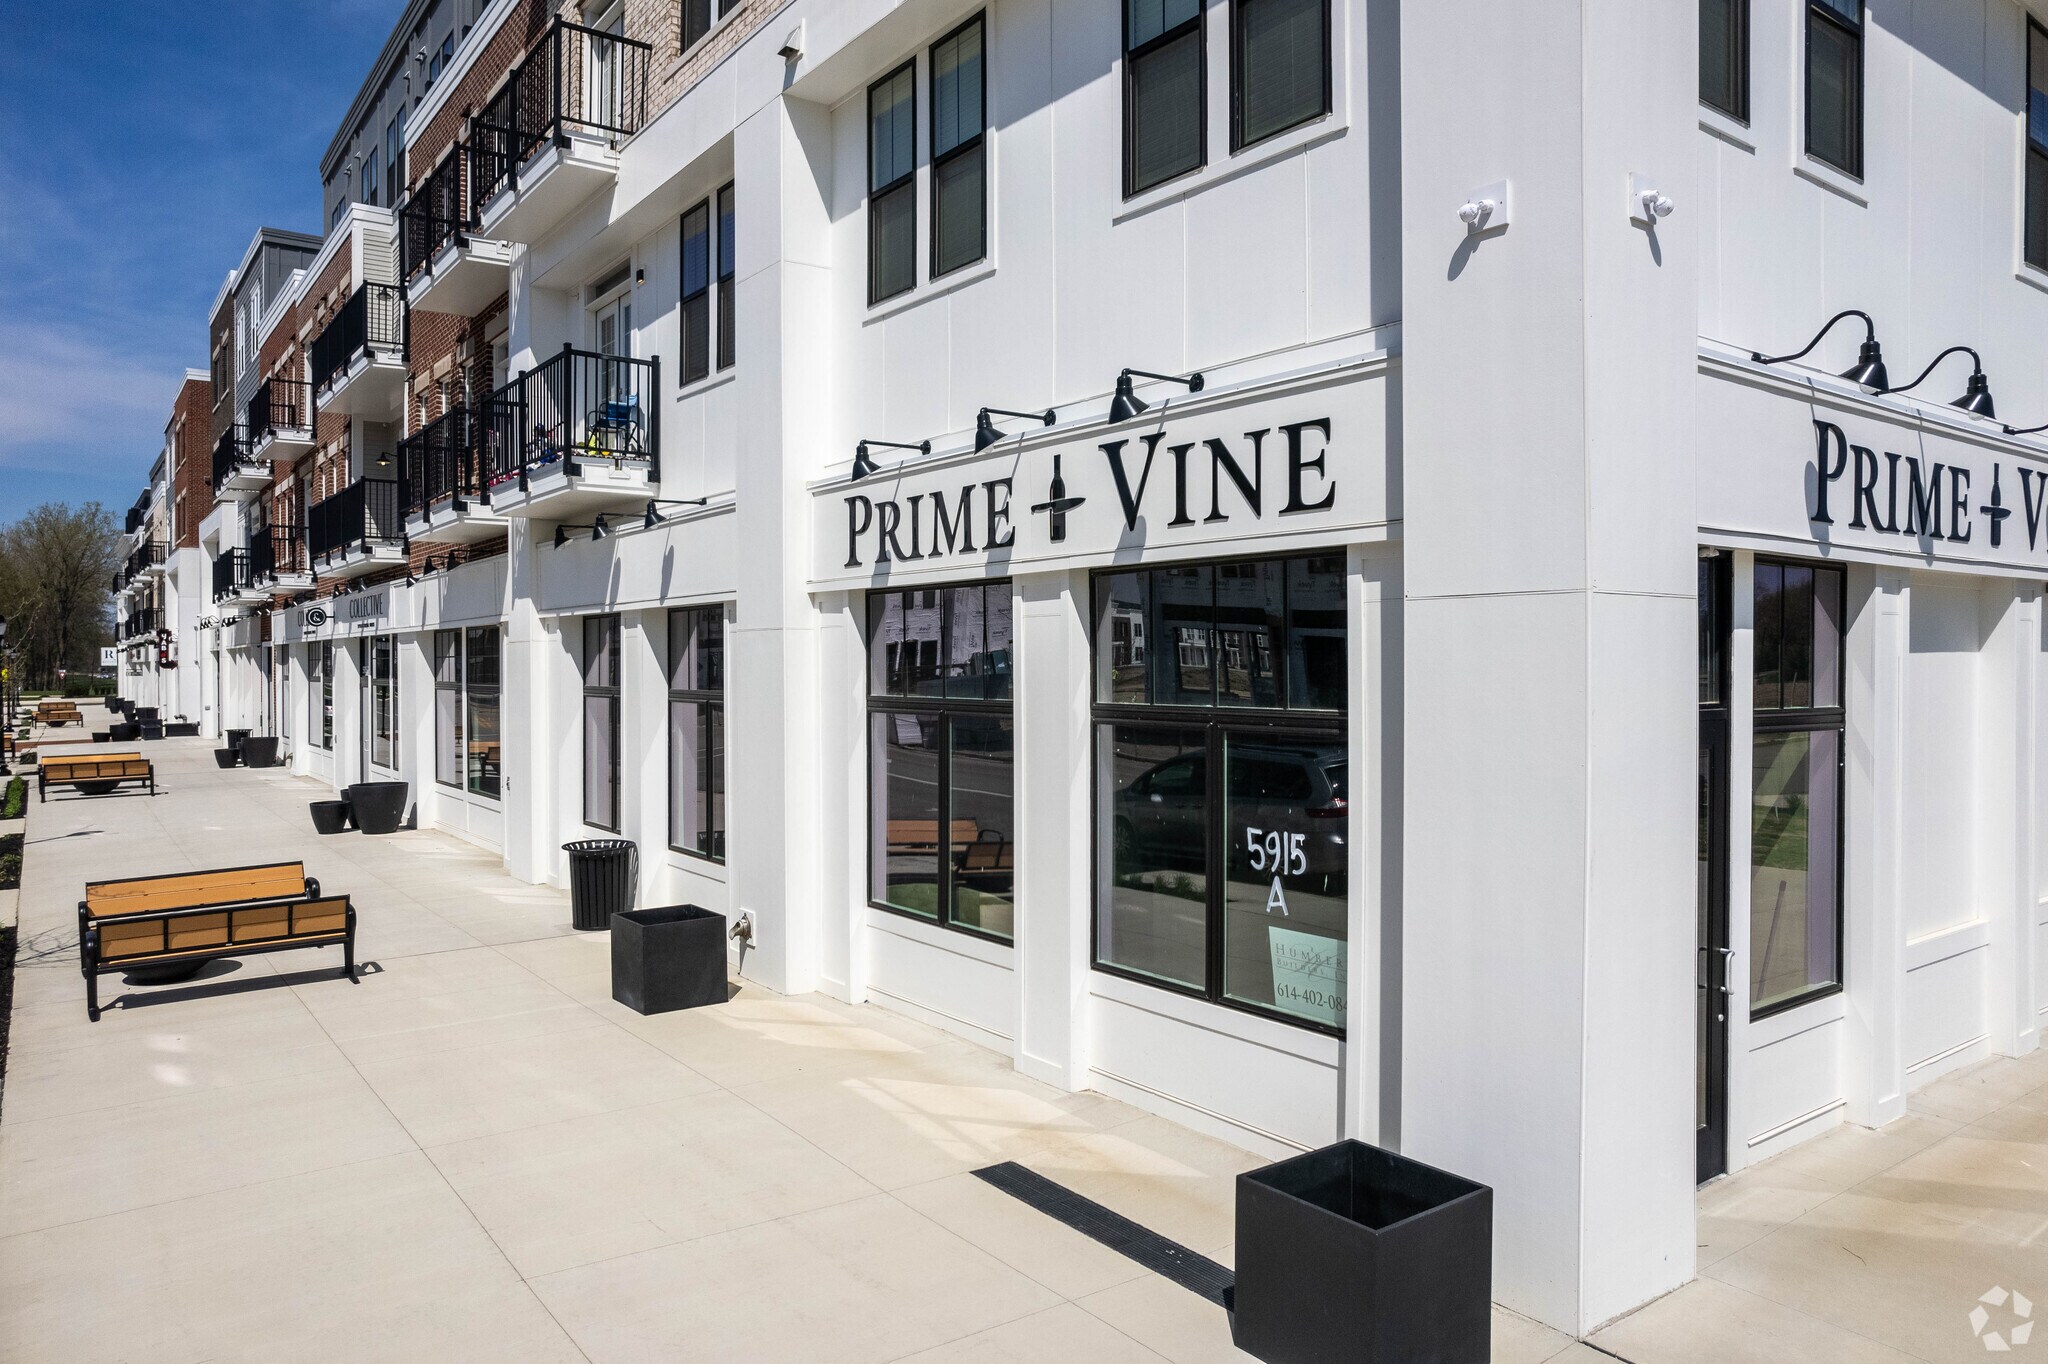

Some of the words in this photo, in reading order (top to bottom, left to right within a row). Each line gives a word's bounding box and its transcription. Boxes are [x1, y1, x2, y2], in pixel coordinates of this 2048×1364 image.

[844, 477, 1016, 567] PRIME
[1098, 417, 1337, 532] VINE
[1811, 419, 1972, 544] PRIME
[2017, 467, 2048, 554] V
[350, 593, 383, 618] COLLECTIVE
[1247, 827, 1307, 876] 5915
[1266, 876, 1289, 916] A
